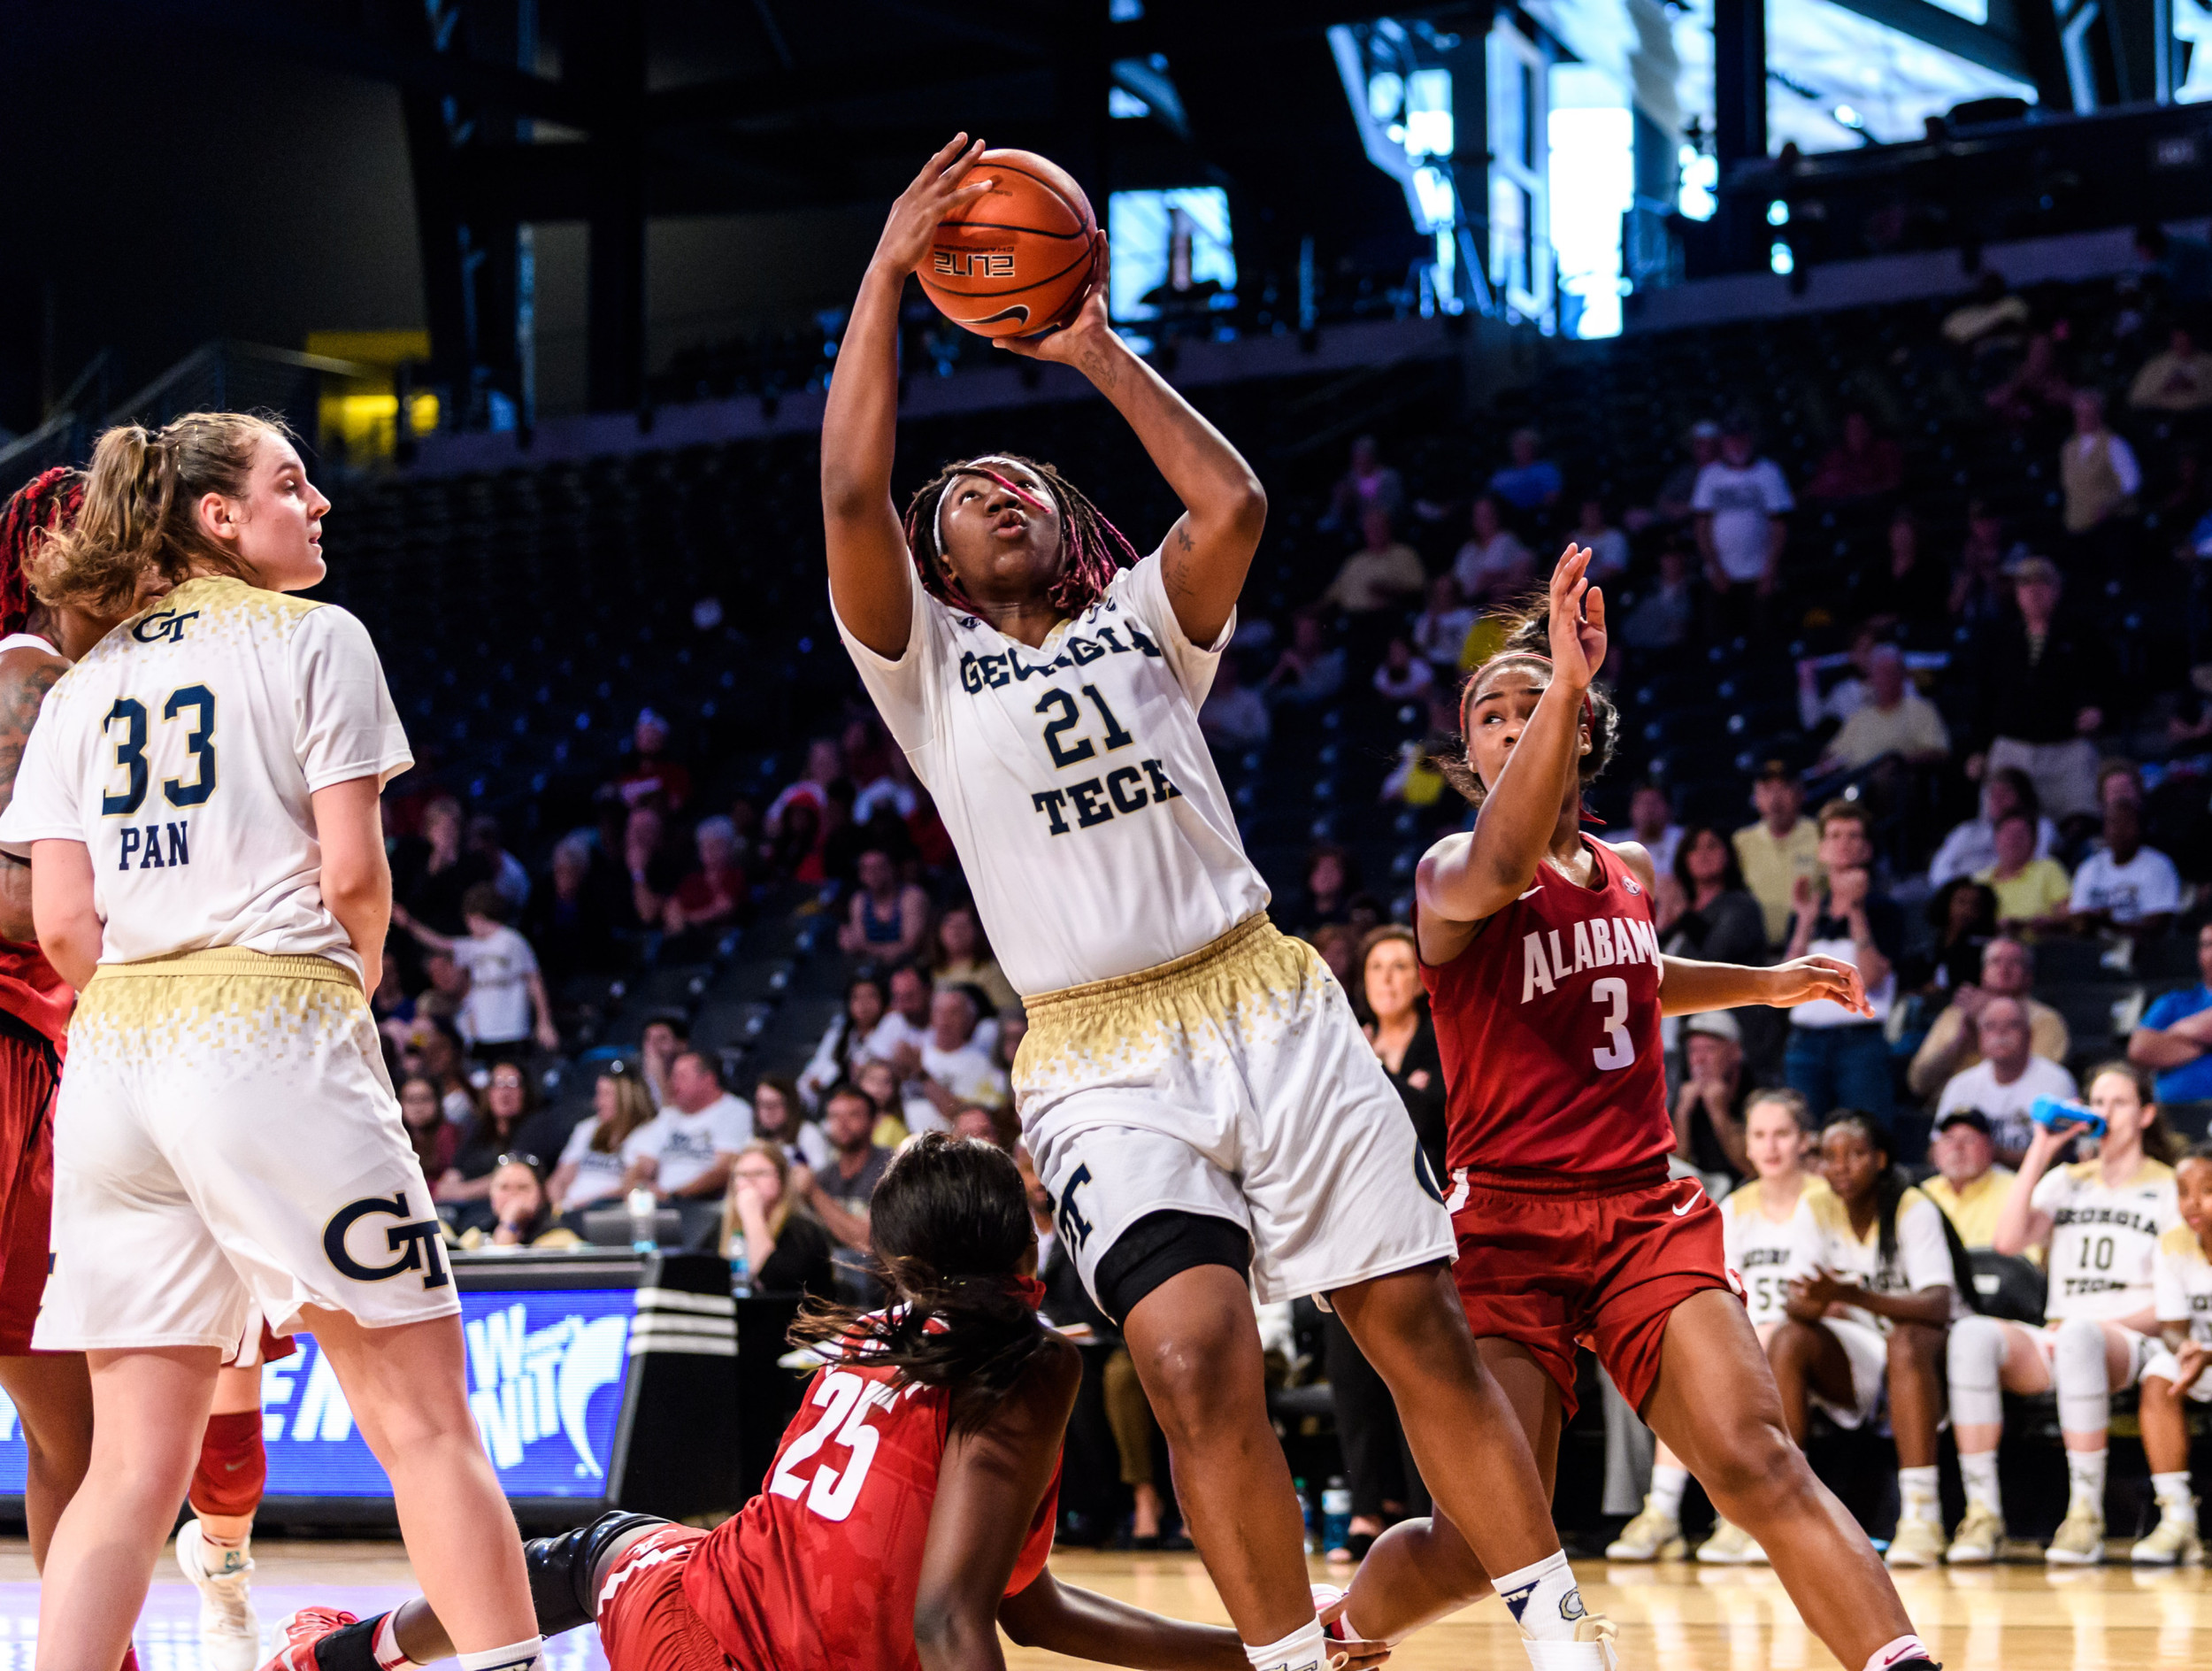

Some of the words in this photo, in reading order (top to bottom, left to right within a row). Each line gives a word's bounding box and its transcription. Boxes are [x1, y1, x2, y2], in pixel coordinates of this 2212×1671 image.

[933, 251, 1016, 278] ELITE
[132, 608, 200, 644] GT
[100, 680, 219, 819] 33
[1033, 682, 1135, 772] 21
[119, 820, 190, 871] PAN
[1591, 977, 1636, 1071] 3
[321, 1190, 449, 1292] GT
[2079, 1236, 2115, 1271] 10
[769, 1370, 896, 1522] 25
